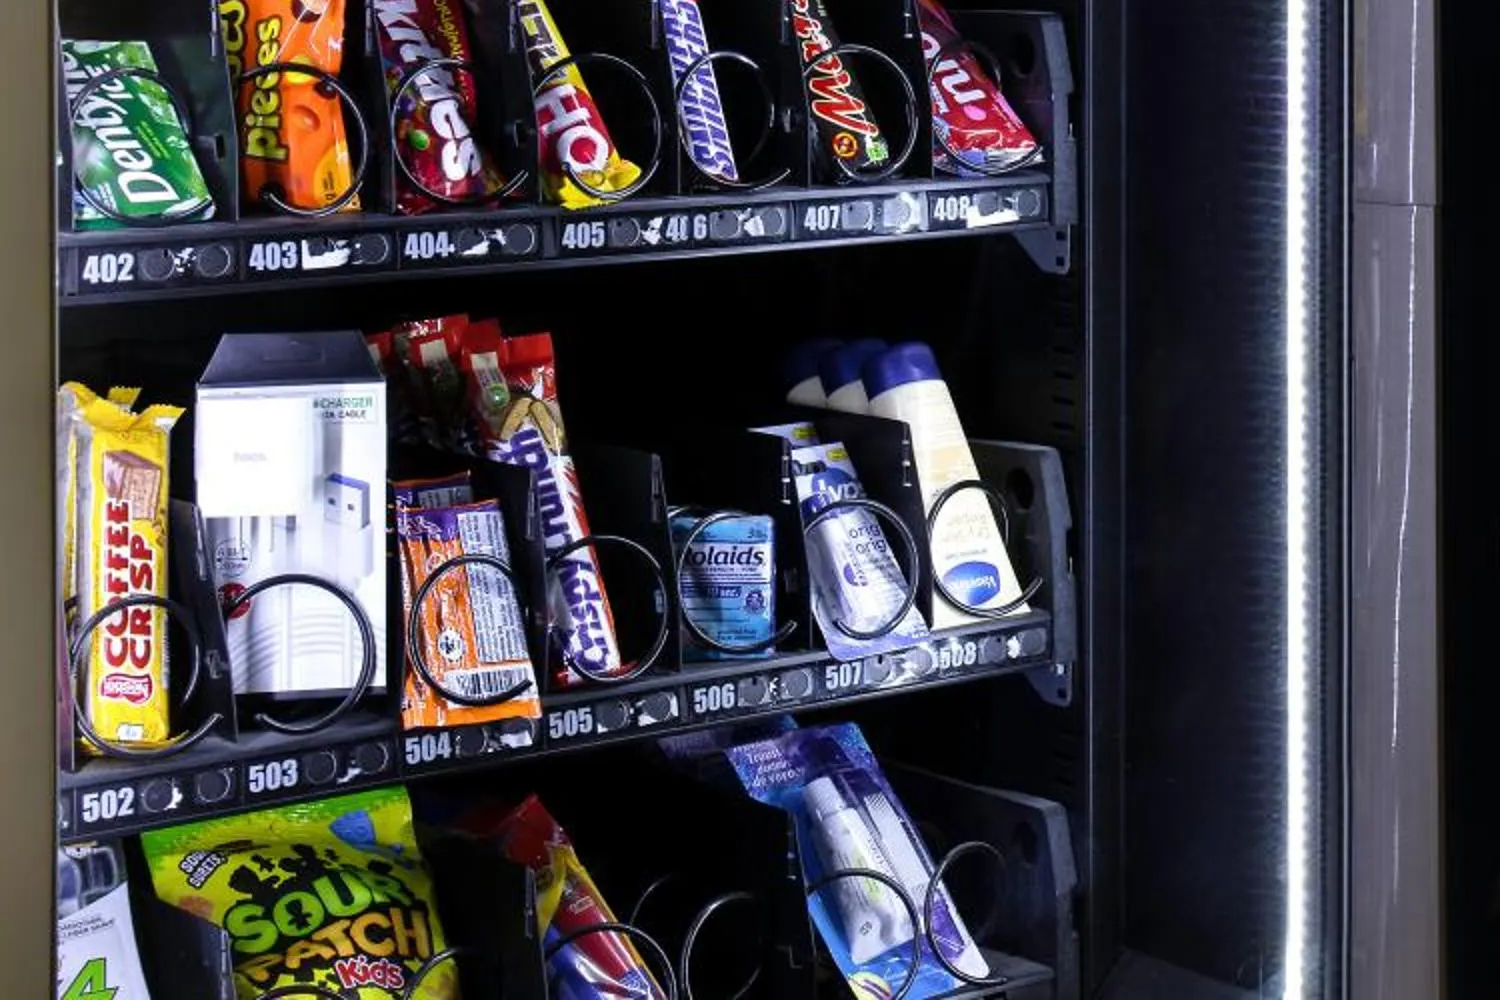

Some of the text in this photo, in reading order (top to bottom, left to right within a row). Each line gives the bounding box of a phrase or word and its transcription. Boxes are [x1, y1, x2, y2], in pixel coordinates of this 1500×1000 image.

[804, 205, 841, 232] 407
[933, 195, 971, 220] 408
[404, 230, 451, 259] 404
[561, 220, 606, 250] 405
[82, 253, 135, 284] 402
[248, 240, 299, 271] 403
[103, 497, 131, 667] COFFEE
[128, 535, 155, 669] CRSP
[938, 641, 976, 668] 508
[825, 665, 864, 692] 507
[693, 685, 736, 713] 506
[548, 710, 593, 740] 505
[405, 734, 452, 765] 504
[248, 759, 300, 793] 503
[82, 786, 136, 824] 502
[225, 864, 414, 953] SOUR
[234, 905, 431, 983] PATCH
[335, 953, 406, 990] Kids
